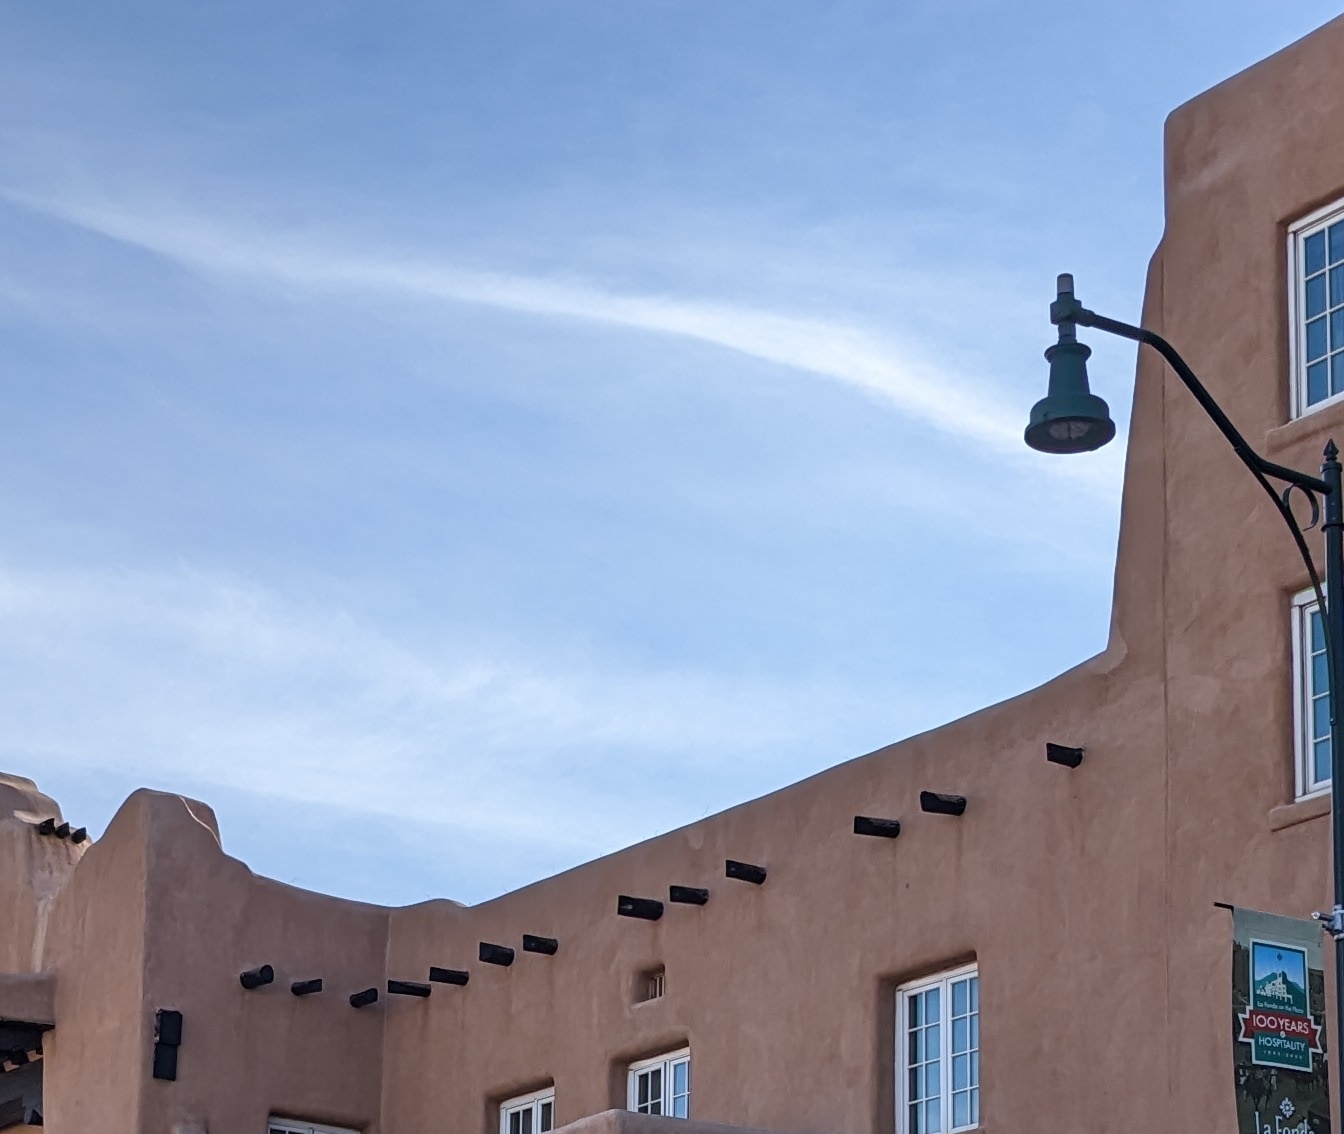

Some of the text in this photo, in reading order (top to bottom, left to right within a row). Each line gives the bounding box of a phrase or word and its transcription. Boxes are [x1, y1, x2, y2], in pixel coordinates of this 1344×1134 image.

[1252, 1014, 1277, 1029] 100
[1277, 1017, 1310, 1035] YEARS
[1258, 1035, 1306, 1052] HOSPITALITY
